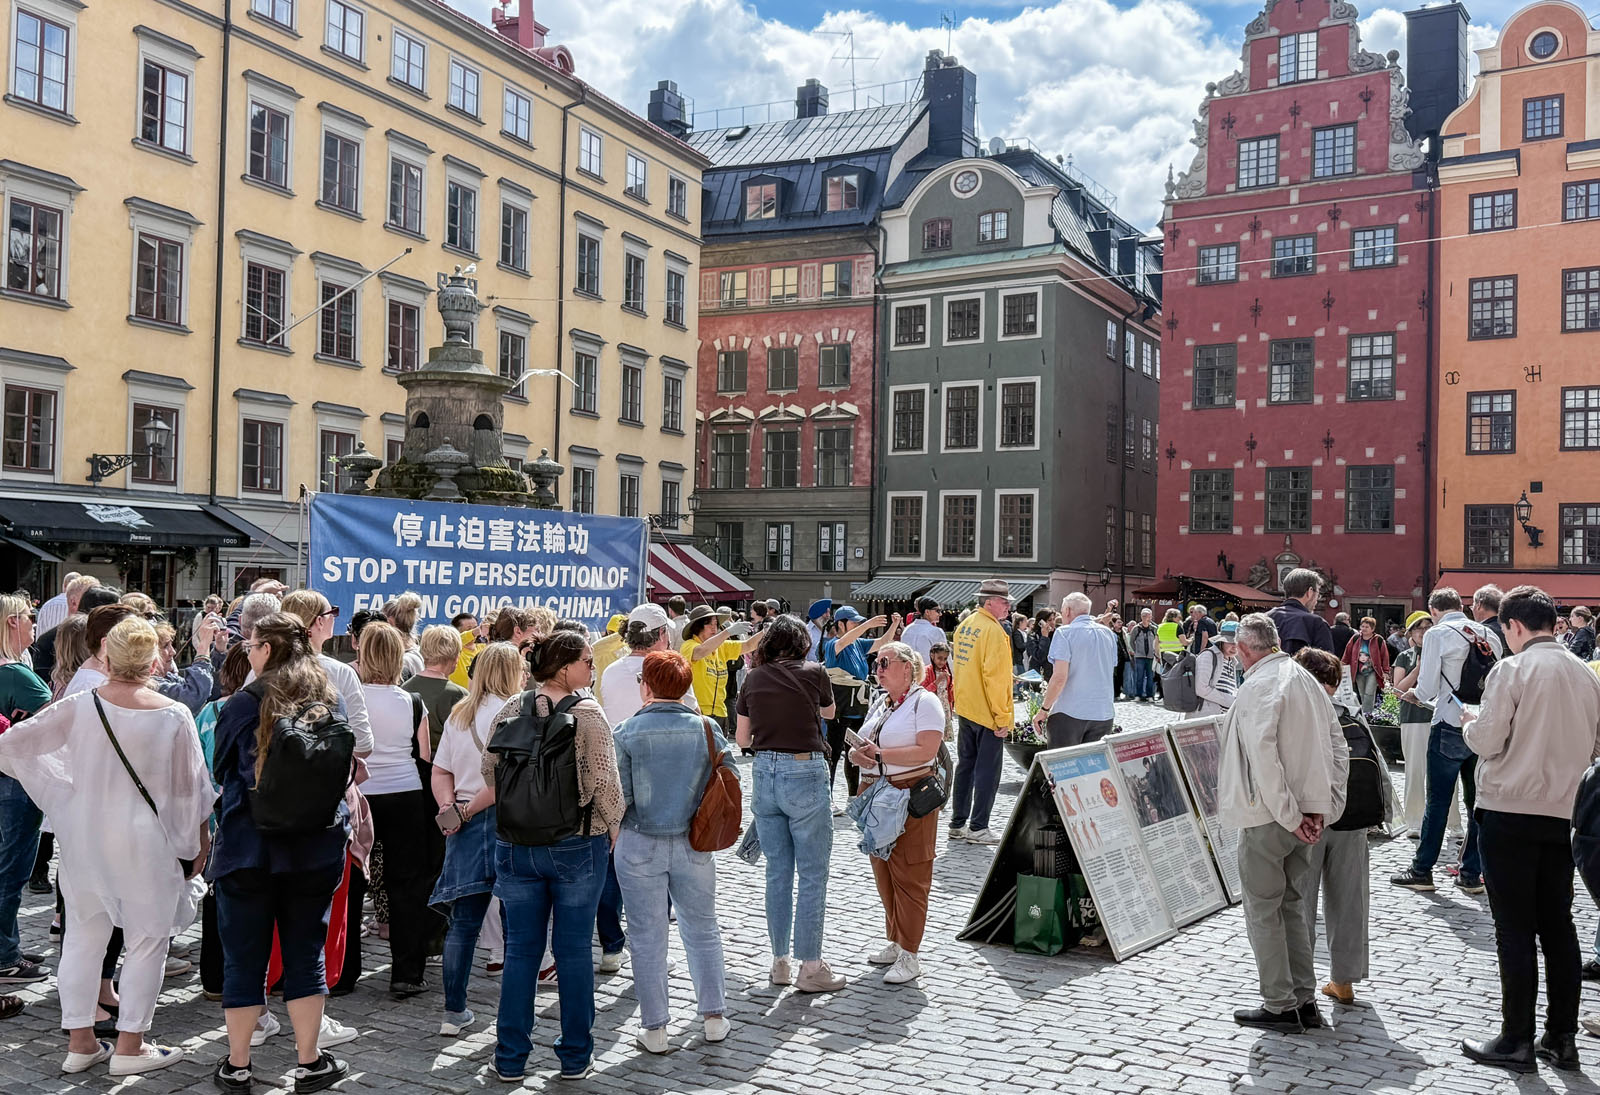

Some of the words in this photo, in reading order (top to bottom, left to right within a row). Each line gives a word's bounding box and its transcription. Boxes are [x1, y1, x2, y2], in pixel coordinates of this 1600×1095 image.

[393, 512, 589, 555] 停止迫害法輪功
[322, 556, 397, 584] STOP
[403, 559, 453, 585] THE
[458, 561, 603, 588] PERSECUTION
[607, 566, 629, 588] OF
[353, 593, 439, 619] FAN
[544, 596, 611, 618] CHINA!
